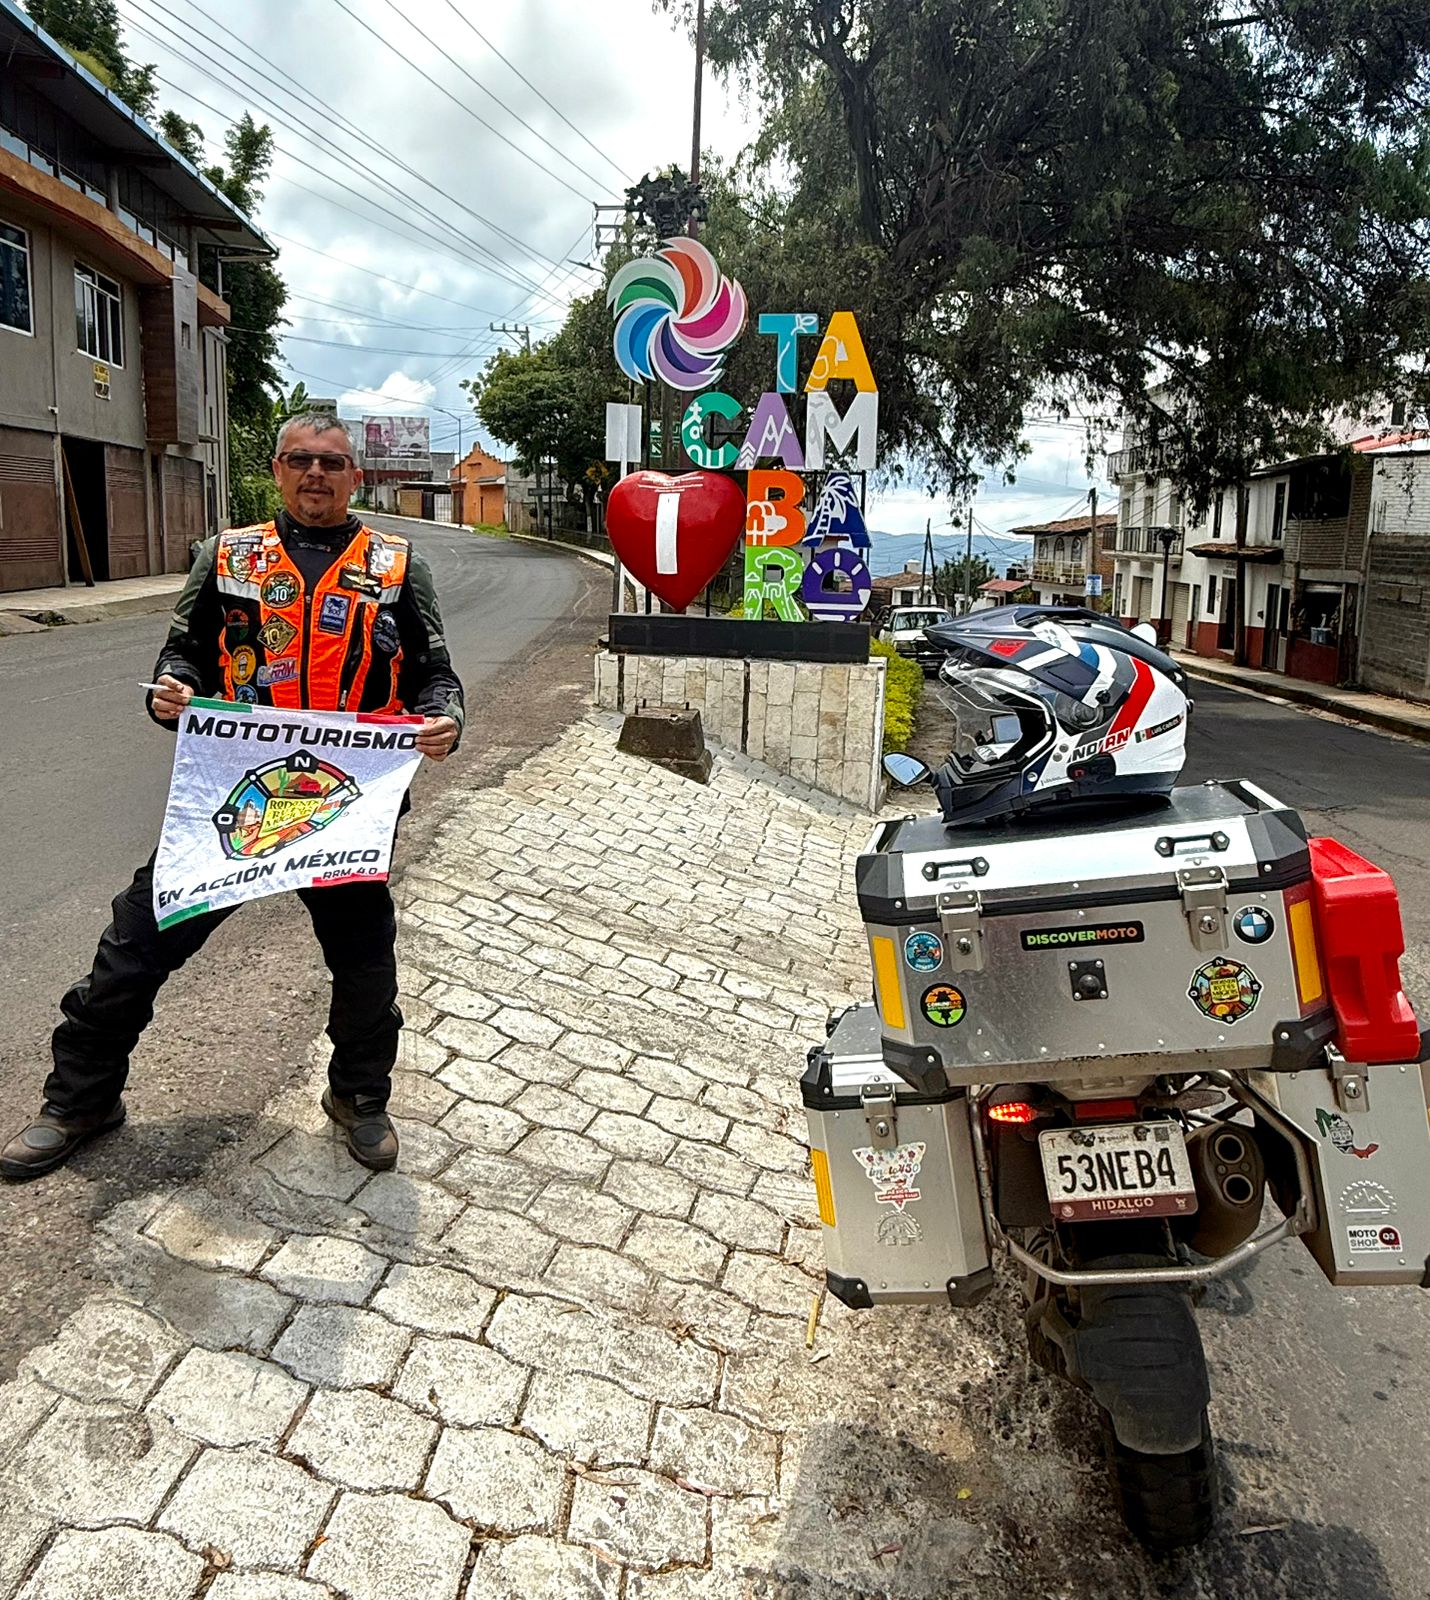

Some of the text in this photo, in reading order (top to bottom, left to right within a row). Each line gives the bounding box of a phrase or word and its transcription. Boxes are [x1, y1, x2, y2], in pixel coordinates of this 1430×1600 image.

[275, 588, 288, 602] 10
[264, 628, 280, 646] 10
[185, 714, 418, 750] MOTOTURISMO
[1067, 729, 1130, 762] NOLAN
[294, 756, 311, 768] N
[217, 814, 230, 825] O
[158, 849, 381, 909] EN ACCIÓN MÉXICO
[322, 866, 378, 881] RRM 4.0
[1236, 907, 1269, 920] BMW
[1026, 926, 1138, 946] DISCOVERMOTO
[1048, 1138, 1057, 1149] T
[1057, 1147, 1177, 1194] 53NEB4
[1091, 1197, 1155, 1211] HIDALGO
[1349, 1229, 1378, 1238] MOTO
[1350, 1237, 1379, 1247] SHOP
